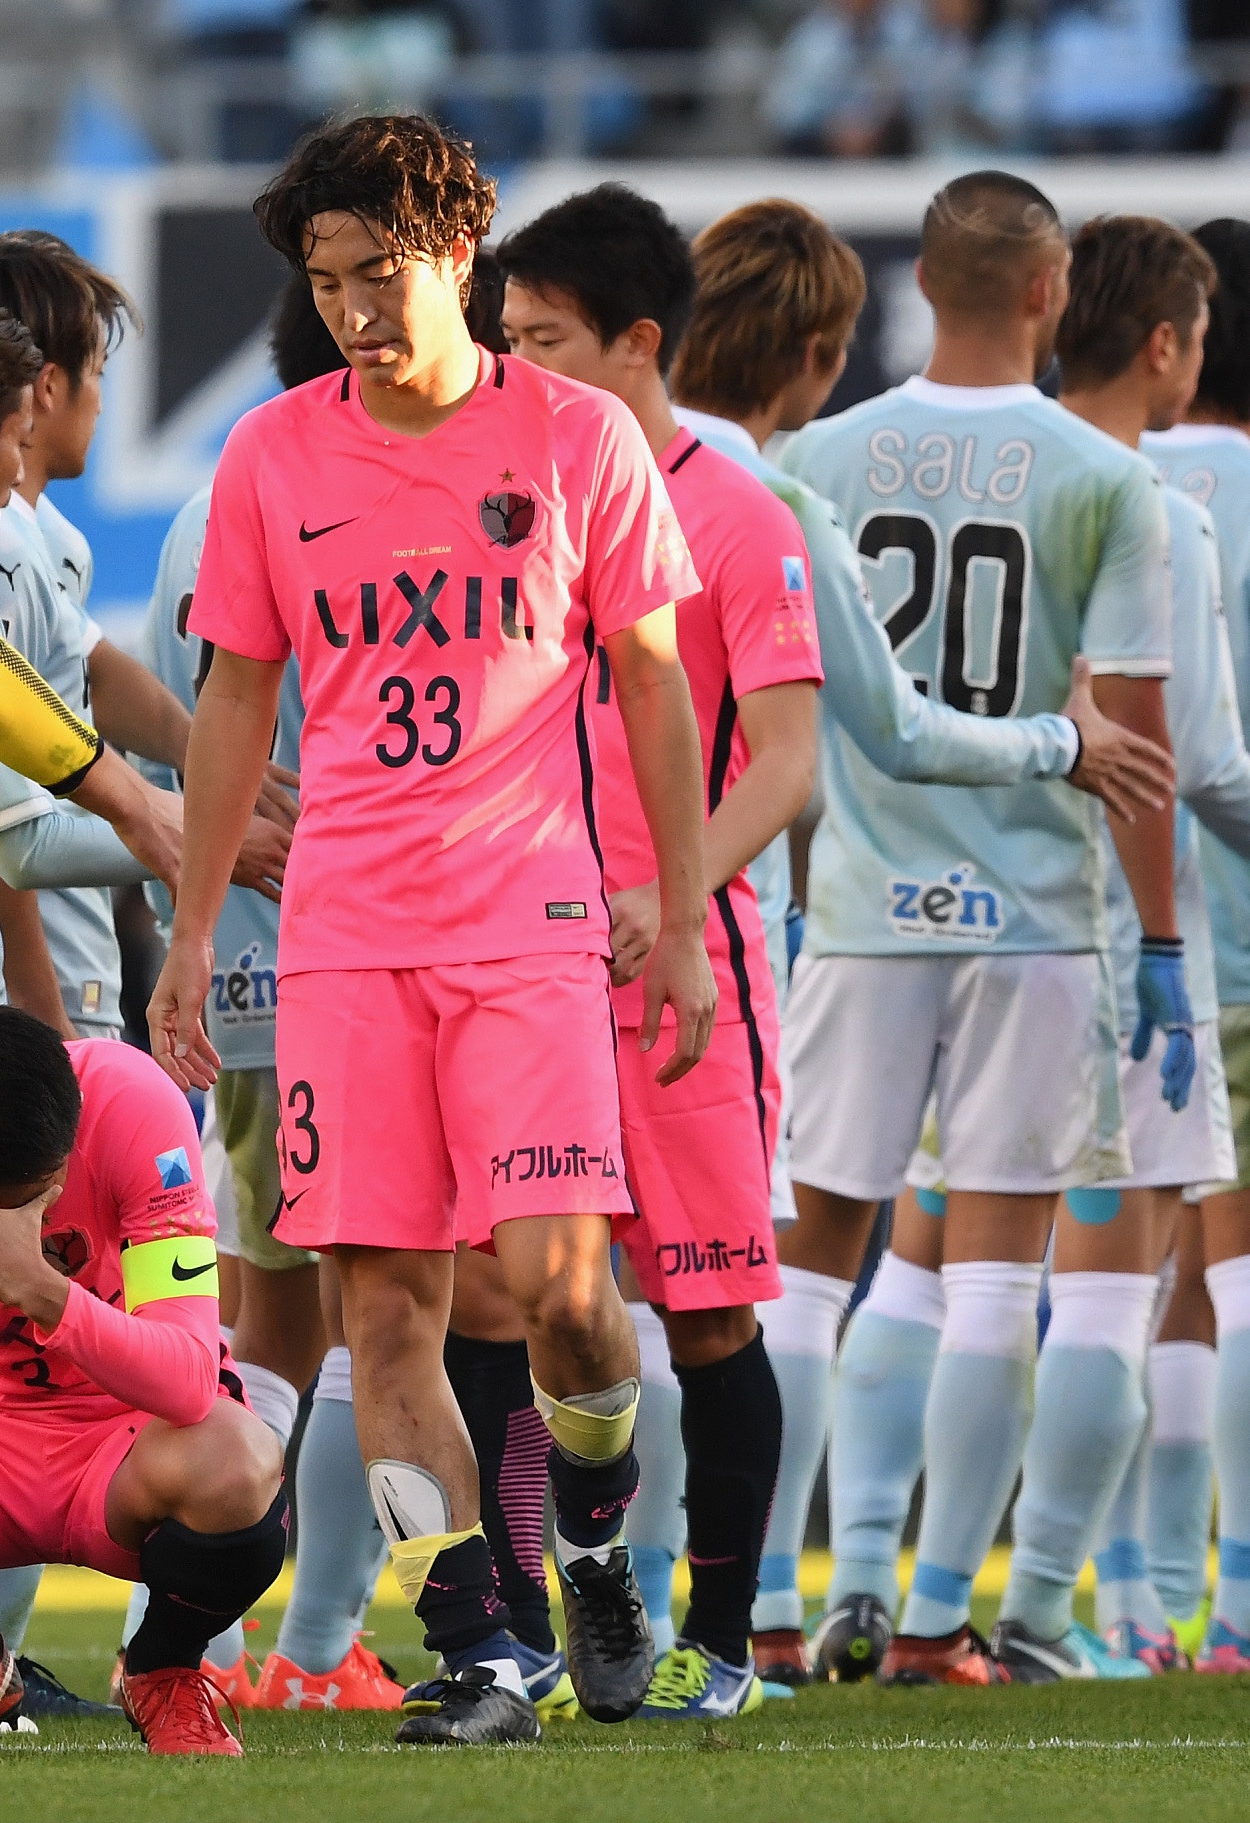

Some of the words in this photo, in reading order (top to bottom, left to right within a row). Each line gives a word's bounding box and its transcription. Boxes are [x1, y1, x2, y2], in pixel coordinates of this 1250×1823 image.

[866, 427, 1036, 505] sala
[313, 568, 535, 649] LIXIL
[855, 508, 1033, 718] 20
[375, 675, 462, 768] 33
[892, 882, 1000, 928] zen
